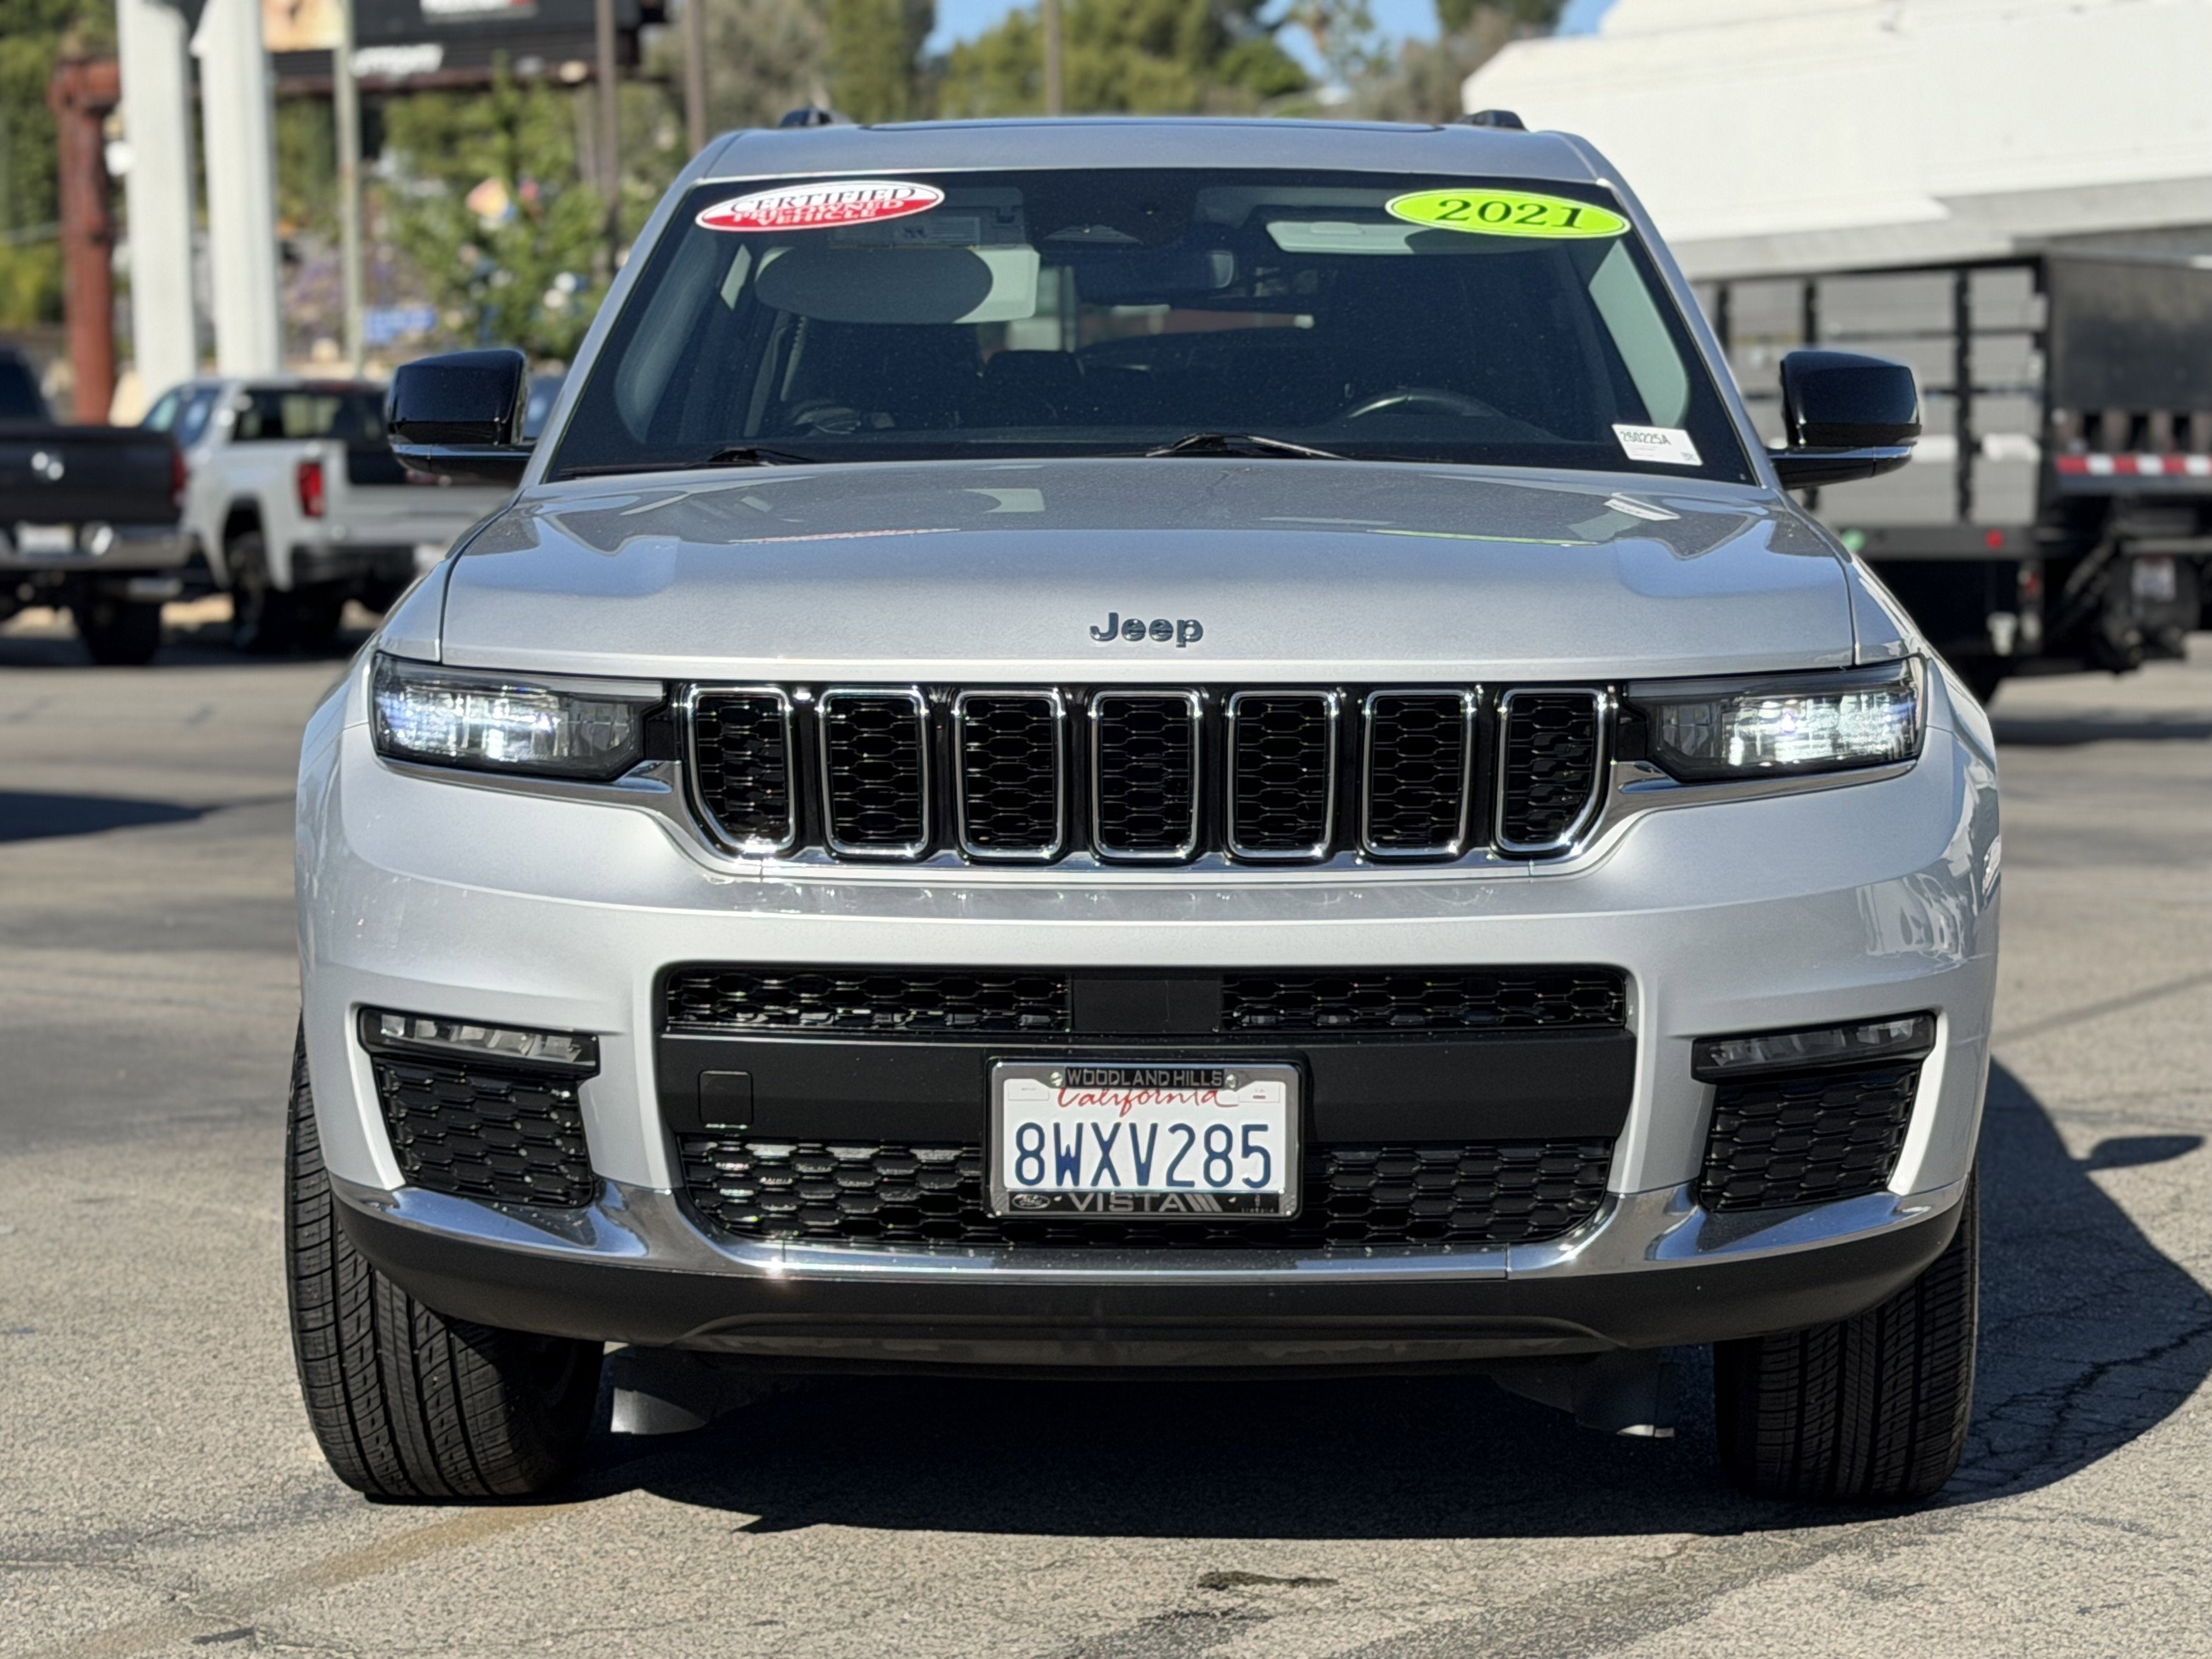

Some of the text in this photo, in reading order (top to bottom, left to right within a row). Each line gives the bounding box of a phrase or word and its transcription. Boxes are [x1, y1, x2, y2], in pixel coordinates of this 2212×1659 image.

[731, 188, 917, 213] CERTIFIED
[1435, 199, 1583, 229] 2021
[757, 208, 877, 226] VEHICLE
[1089, 612, 1204, 648] Jeep
[1066, 1069, 1223, 1087] WOODLAND HILLS
[1057, 1087, 1239, 1118] California
[1015, 1121, 1271, 1188] 8WXV285
[1068, 1193, 1188, 1212] VISTA
